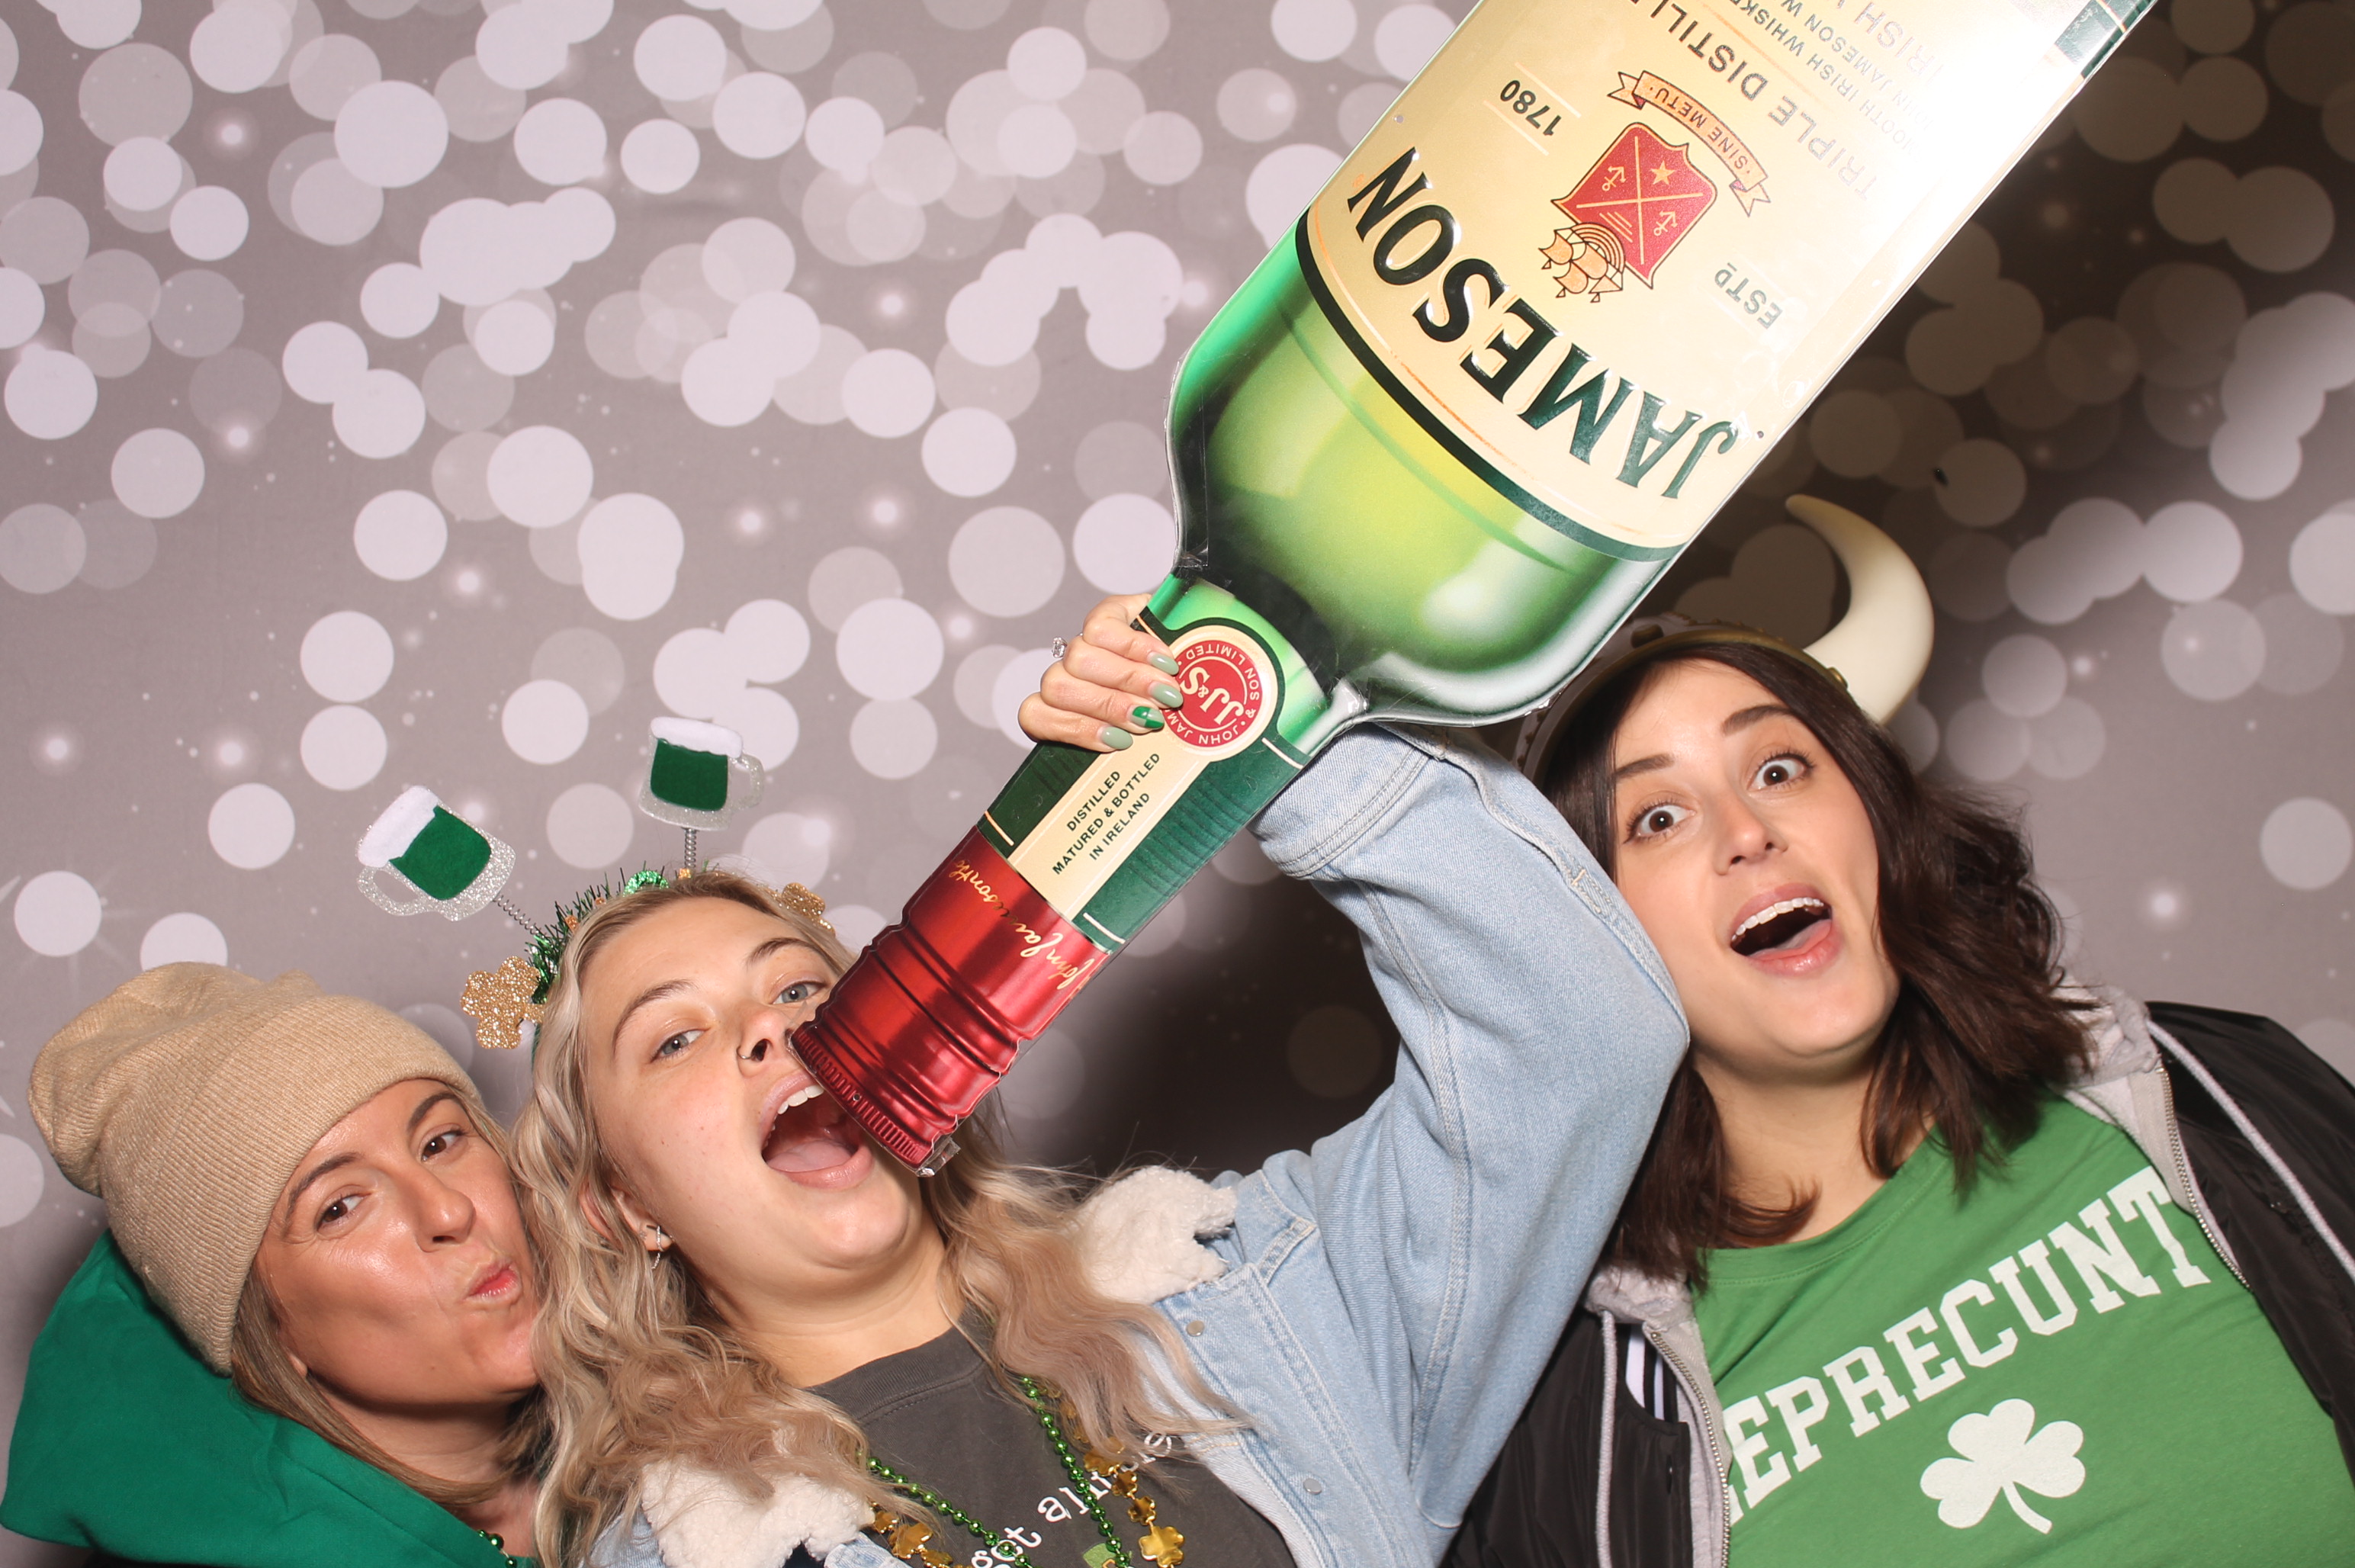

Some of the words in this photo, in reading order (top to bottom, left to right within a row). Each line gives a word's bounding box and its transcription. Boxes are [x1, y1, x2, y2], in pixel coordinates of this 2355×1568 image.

[1631, 0, 1768, 101] DISTILL
[1804, 14, 1893, 91] JAMESON
[1807, 53, 1859, 101] IRISH
[1500, 79, 1562, 137] 1780
[1655, 88, 1708, 128] METU
[1859, 99, 1922, 163] MOOTH
[1708, 127, 1748, 169] SINE
[1768, 95, 1881, 201] TRIPLE
[1347, 146, 1739, 499] JAMESON
[1186, 644, 1245, 665] LIMITED
[1245, 667, 1259, 701] SON
[1199, 725, 1239, 744] JOHN
[1245, 708, 1256, 718] &
[1052, 818, 1104, 875] MATURED
[1104, 807, 1114, 818] &
[1112, 753, 1160, 808] BOTTLED
[1066, 771, 1120, 831] DISTILLED
[1089, 845, 1104, 861] IN
[1103, 793, 1149, 846] IRELAND
[1046, 949, 1095, 990] John
[1724, 1166, 2212, 1525] EPRECUNT
